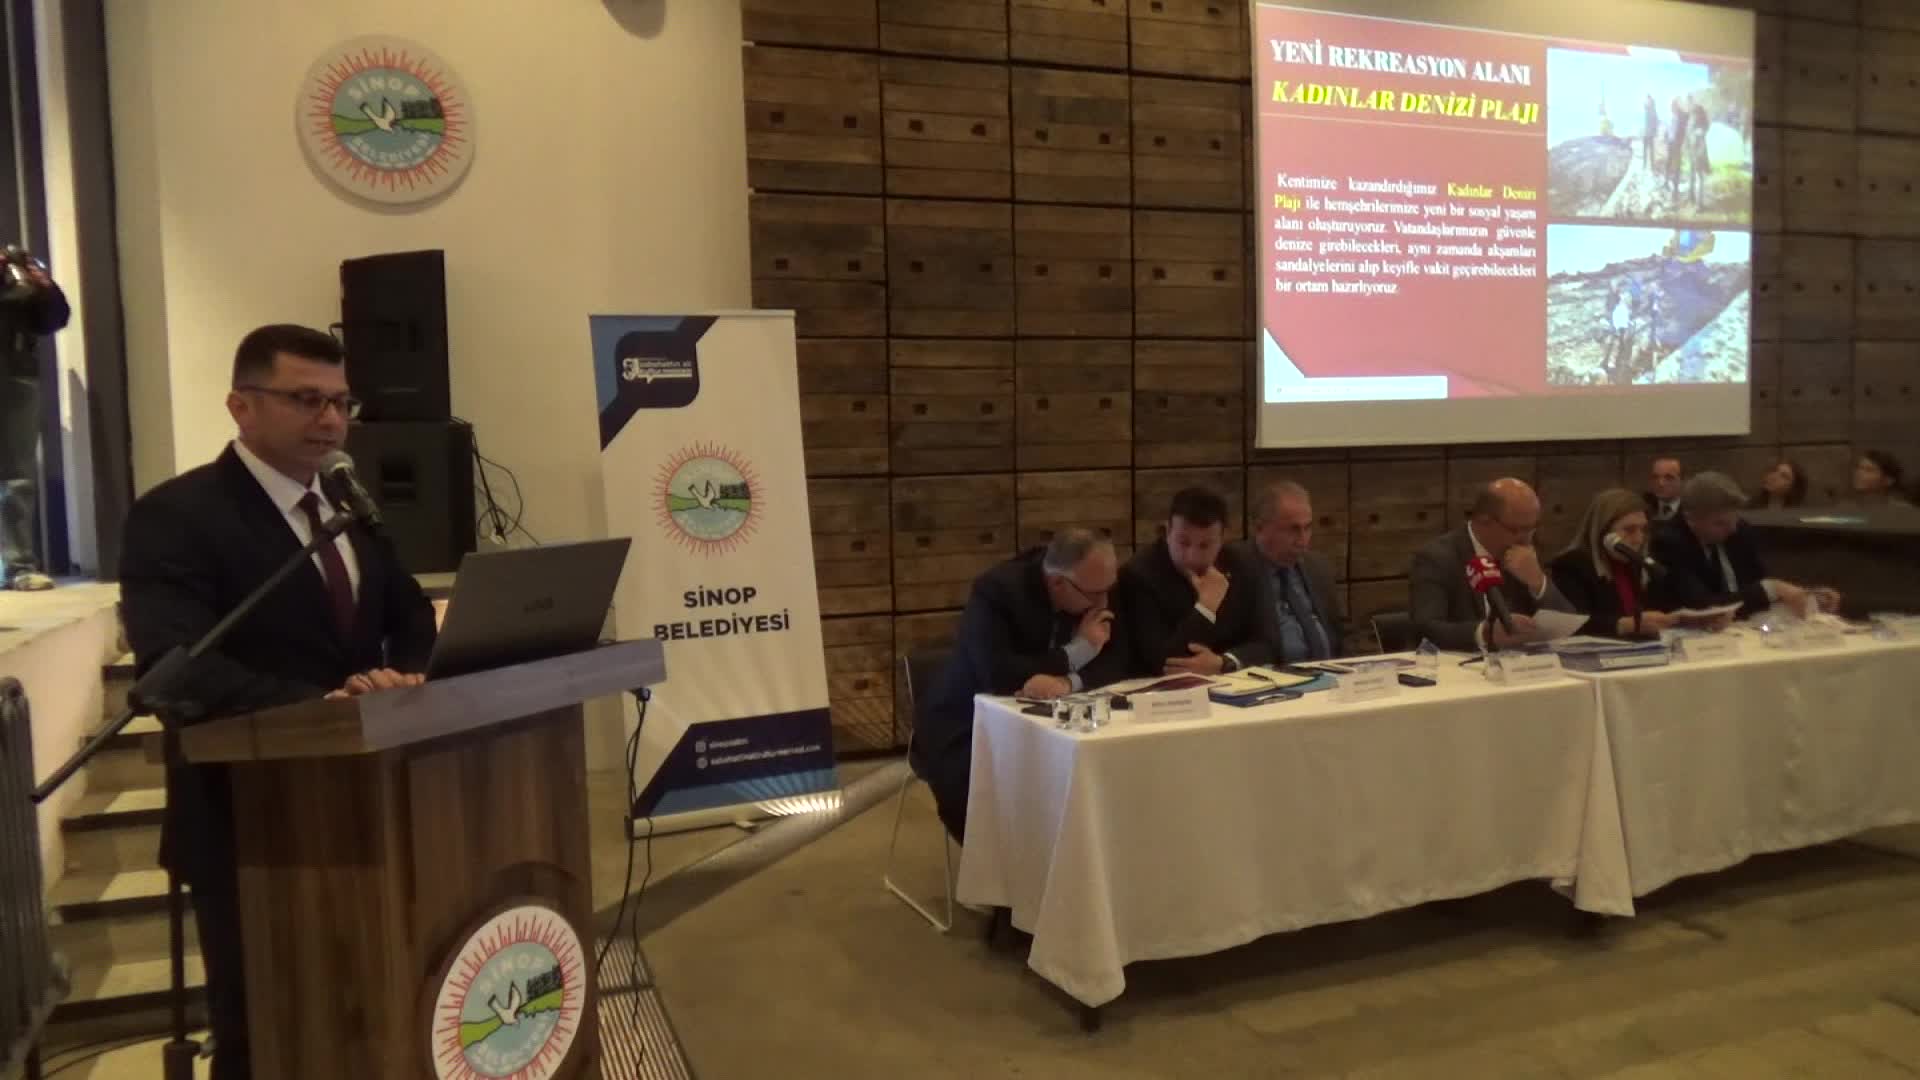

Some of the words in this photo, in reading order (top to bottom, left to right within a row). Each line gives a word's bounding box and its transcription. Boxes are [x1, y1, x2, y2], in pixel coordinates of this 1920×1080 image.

[1270, 39, 1322, 65] YENİ
[1327, 45, 1466, 79] REKREASYON
[1471, 60, 1531, 86] ALANI
[1272, 80, 1395, 111] KADINLAR
[1400, 91, 1476, 118] DENİZİ
[1480, 98, 1539, 125] PLAJI
[1277, 173, 1337, 190] Kentimize
[1305, 195, 1320, 210] ile
[1424, 203, 1446, 219] yeni
[1449, 202, 1465, 217] bir
[1468, 205, 1501, 221] sosyal
[1274, 216, 1303, 231] alanı
[1275, 237, 1313, 251] denize
[1408, 244, 1431, 258] aynı
[1437, 243, 1482, 257] zamanda
[1275, 258, 1355, 276] sandalyelerini
[1359, 260, 1380, 277] alıp
[1382, 260, 1419, 277] keyifle
[1424, 261, 1450, 275] vakit
[1275, 278, 1292, 293] bir
[1295, 280, 1328, 293] ortam
[684, 585, 757, 608] SİNOP
[654, 608, 790, 641] BELEDİYESİ
